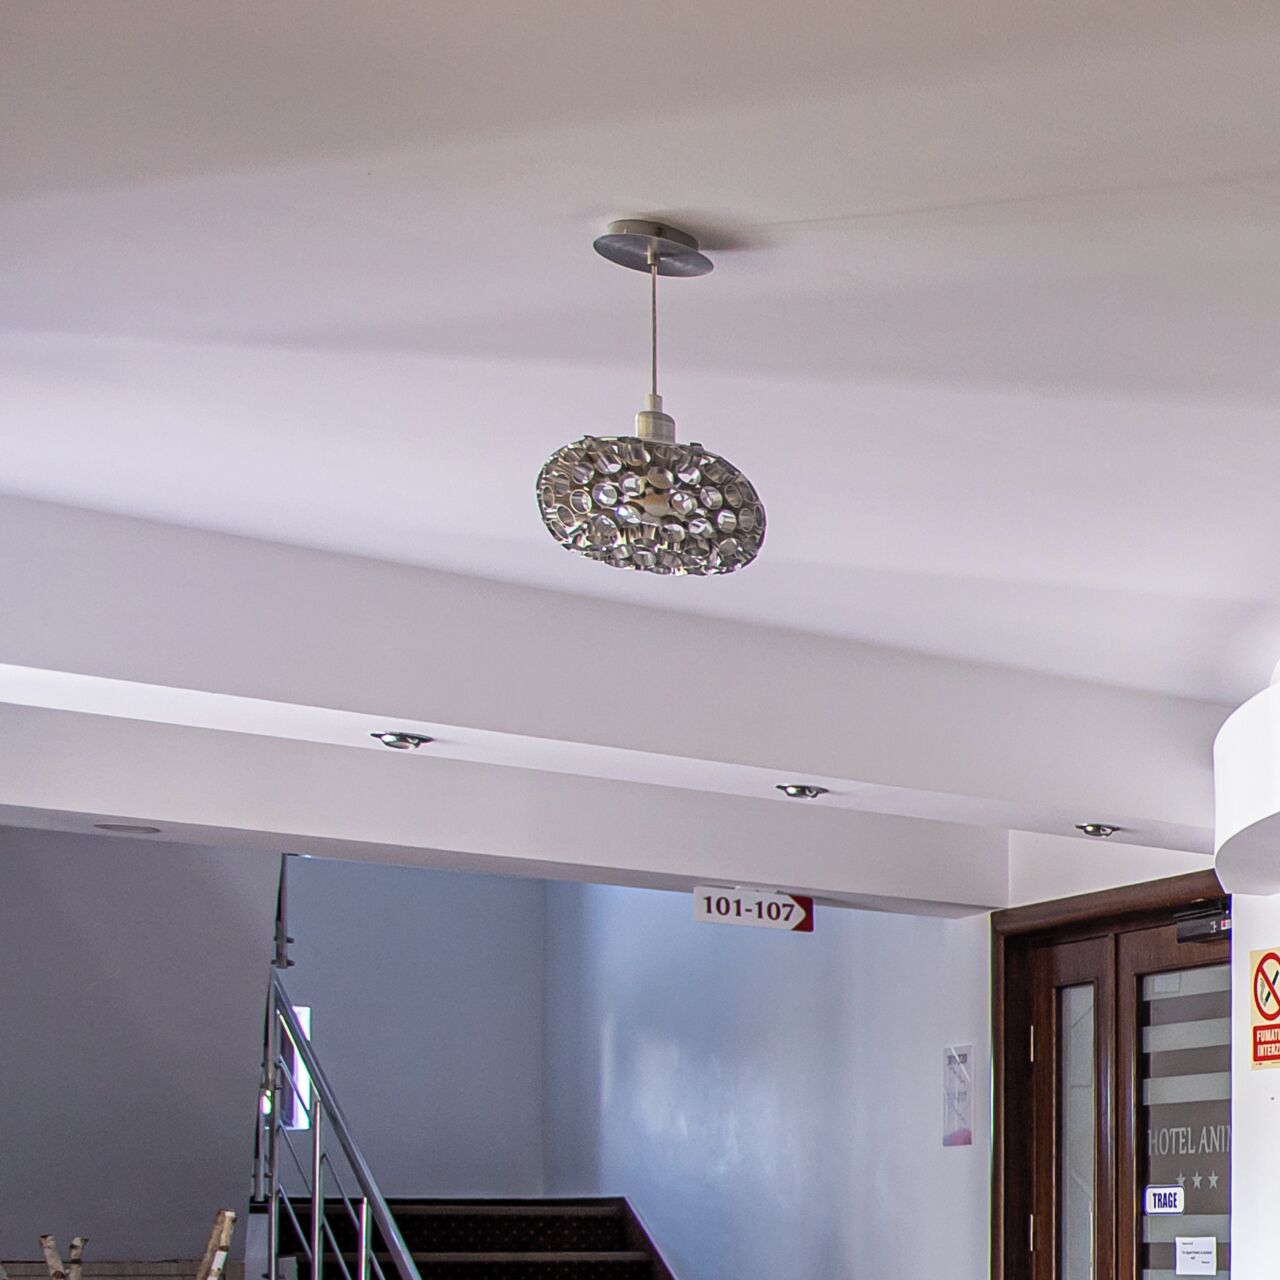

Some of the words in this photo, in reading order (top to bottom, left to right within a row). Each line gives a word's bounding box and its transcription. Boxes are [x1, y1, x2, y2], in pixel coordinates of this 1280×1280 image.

[703, 895, 796, 922] 101-107
[1148, 1127, 1196, 1156] HOTEL
[1152, 1192, 1177, 1208] TRAGE
